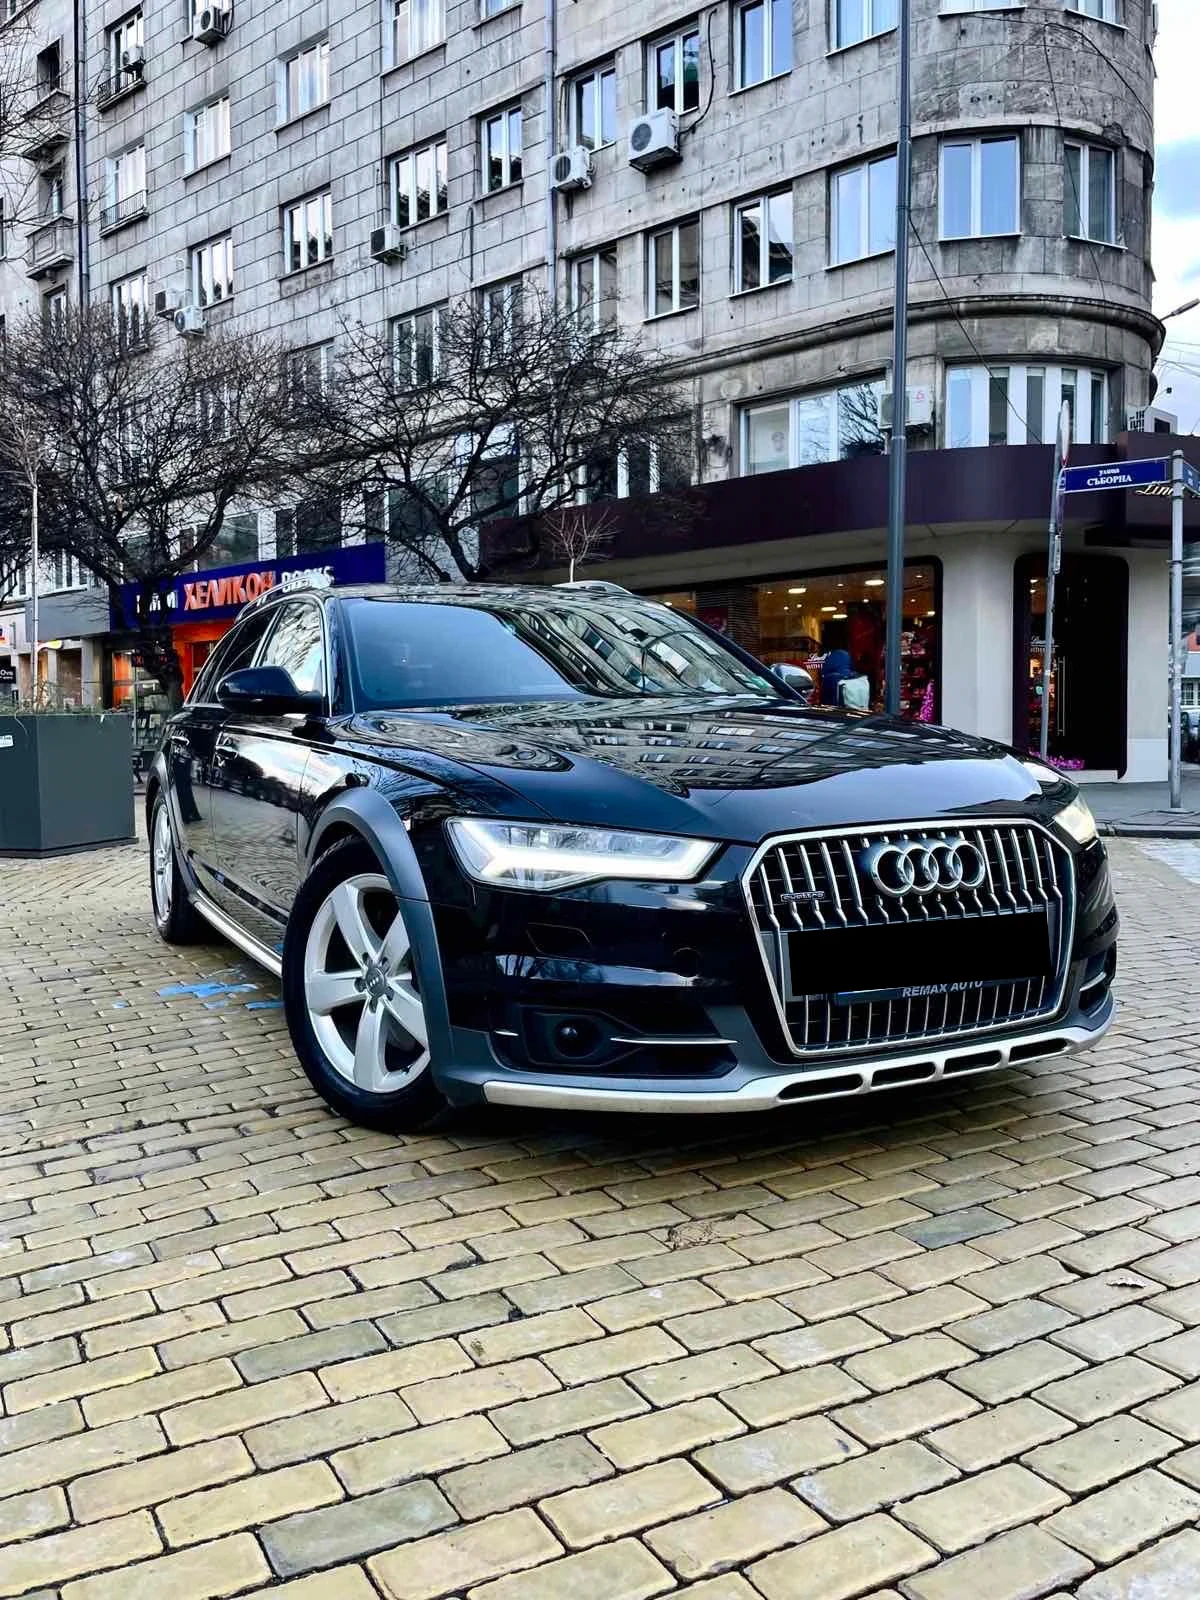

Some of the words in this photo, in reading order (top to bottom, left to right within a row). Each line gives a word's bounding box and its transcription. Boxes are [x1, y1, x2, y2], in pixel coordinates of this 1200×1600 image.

[1087, 474, 1133, 486] СЪБОРНА
[902, 983, 948, 998] REMAX
[950, 980, 984, 993] AUTO
